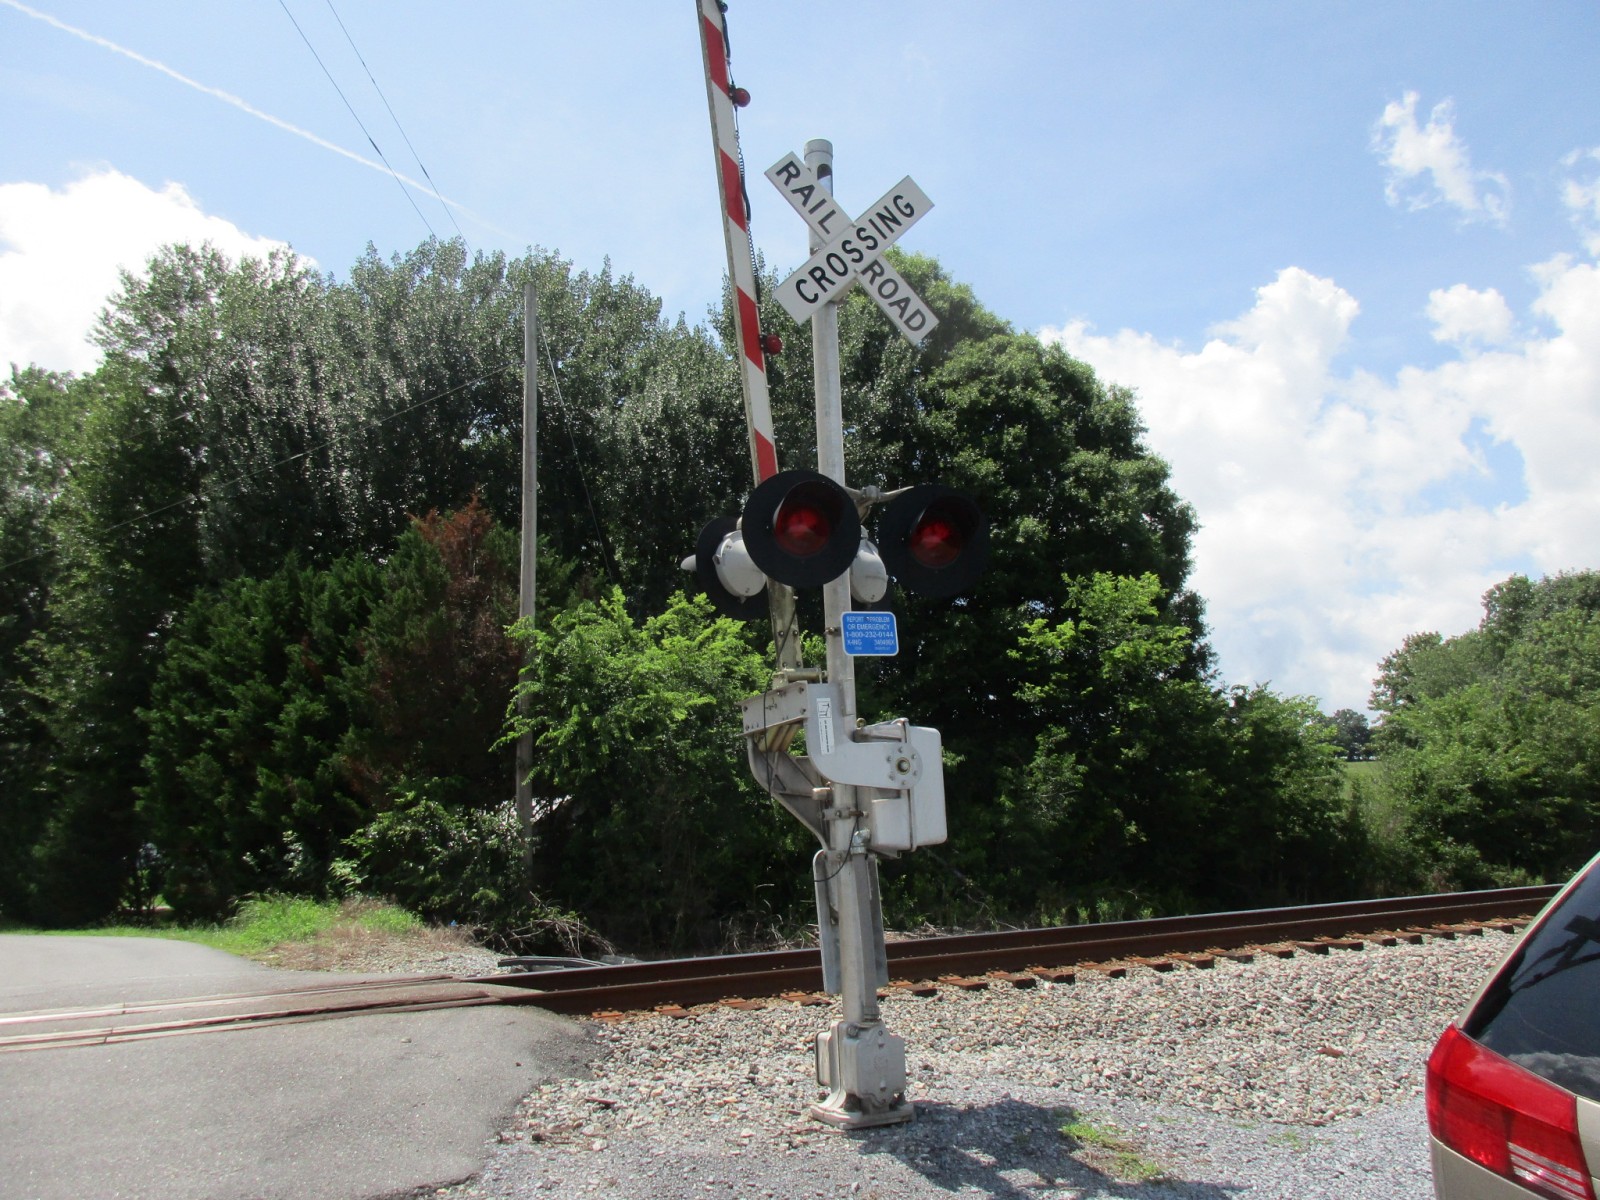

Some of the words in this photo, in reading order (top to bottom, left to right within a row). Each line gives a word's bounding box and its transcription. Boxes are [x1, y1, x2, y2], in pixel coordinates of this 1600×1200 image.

[775, 160, 837, 235] RAIL
[860, 259, 927, 332] ROAD
[795, 194, 915, 304] CROSSING
